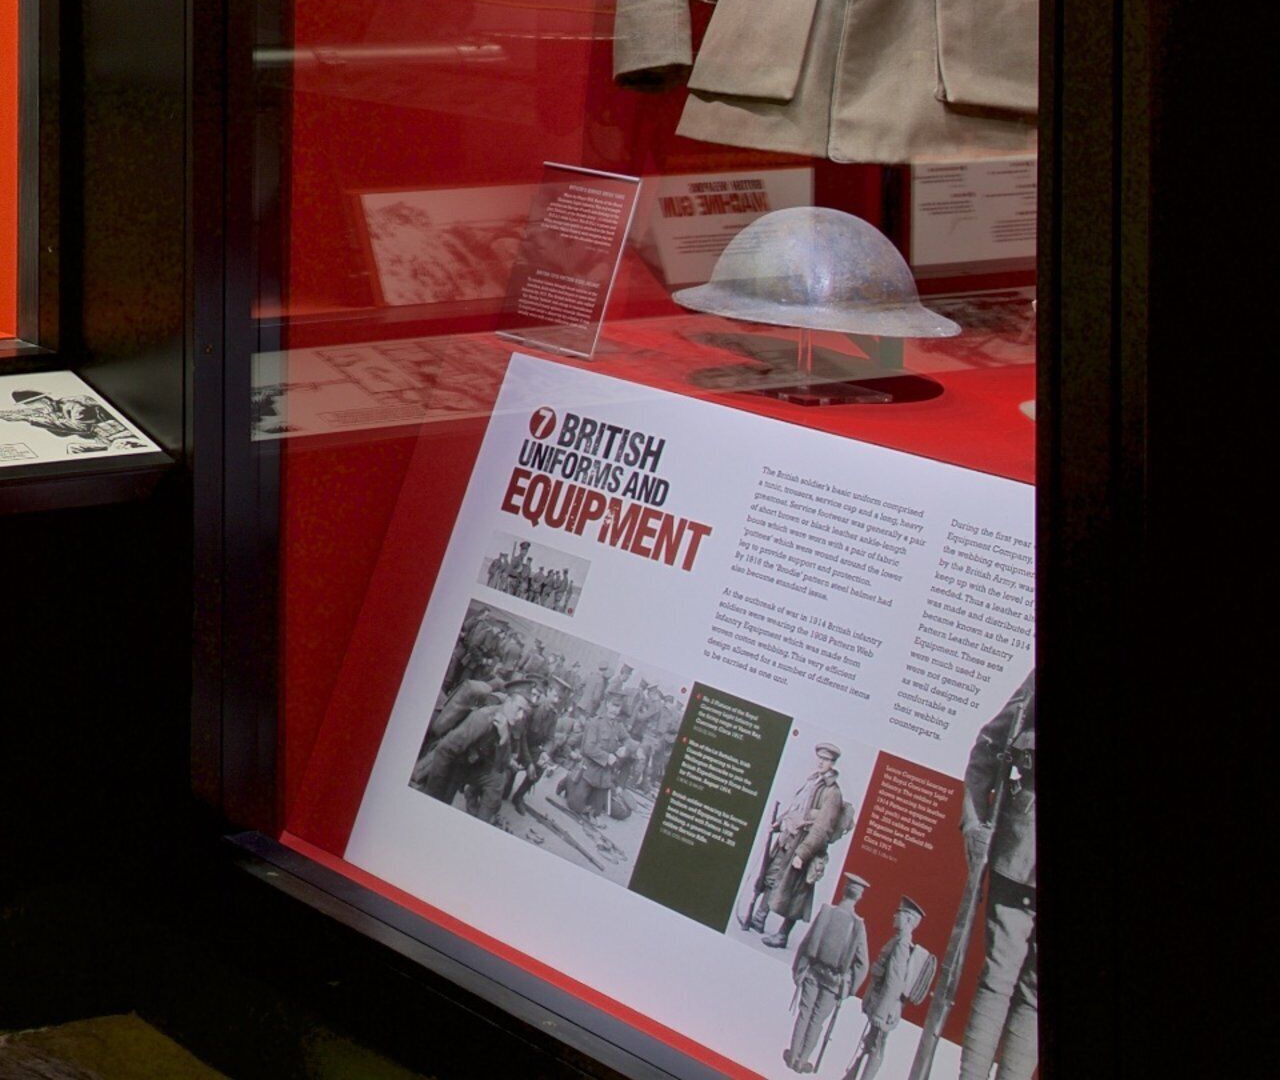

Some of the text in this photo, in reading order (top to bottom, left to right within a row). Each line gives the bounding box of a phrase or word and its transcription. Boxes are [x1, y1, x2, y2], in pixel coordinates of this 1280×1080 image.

[535, 409, 665, 472] 7 BRITISH
[519, 439, 670, 507] UNIFORMS AND
[501, 467, 713, 572] EQUIPMENT
[951, 518, 1032, 548] During the first year
[943, 545, 955, 555] the
[958, 550, 993, 567] webbing
[947, 532, 1033, 564] Equipment Company,
[935, 571, 955, 584] keep
[957, 579, 967, 588] up
[969, 583, 986, 593] with
[988, 588, 1001, 597] the
[1002, 591, 1023, 604] level
[939, 559, 1034, 593] by the British Army, was
[927, 599, 1032, 636] was made and distributed
[965, 594, 983, 607] Thus
[992, 603, 1022, 618] leather
[918, 624, 1013, 661] Pattern Leather Infantry
[923, 610, 1031, 651] became known as the 1914
[910, 651, 991, 683] were much used but
[961, 651, 985, 666] These
[987, 661, 1004, 672] sets
[902, 677, 980, 709] as well designed or
[906, 664, 981, 695] were not generally
[894, 703, 949, 729] their webbing
[897, 690, 957, 715] comfortable as
